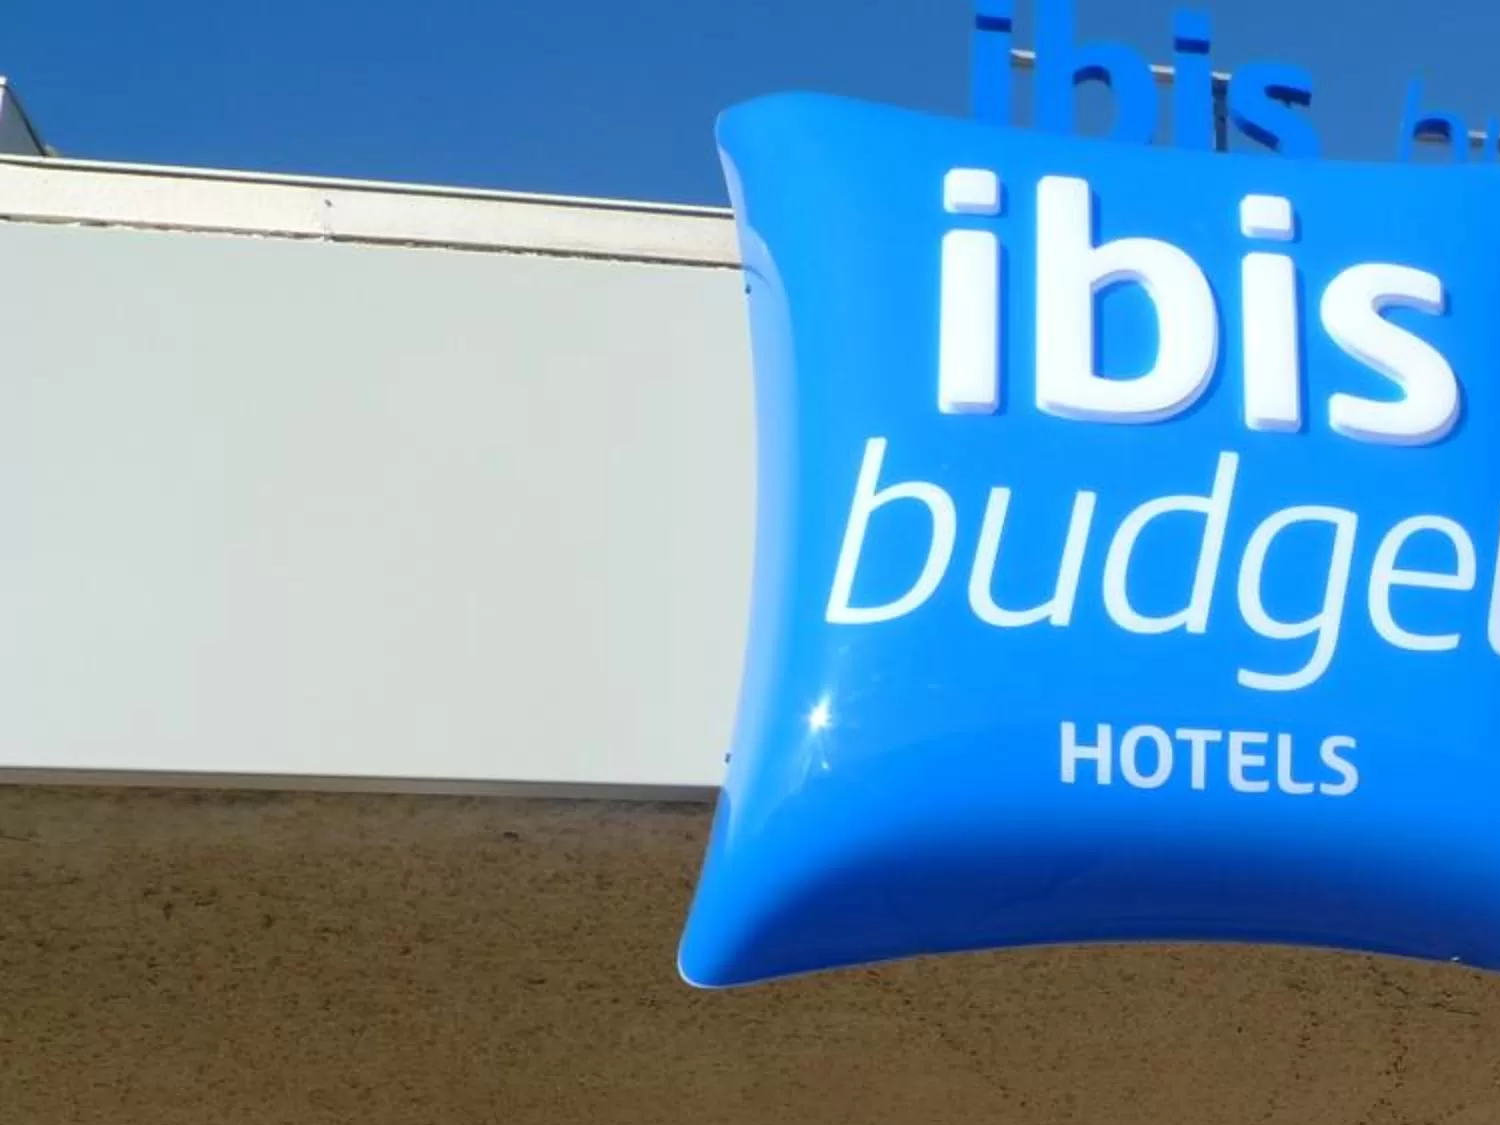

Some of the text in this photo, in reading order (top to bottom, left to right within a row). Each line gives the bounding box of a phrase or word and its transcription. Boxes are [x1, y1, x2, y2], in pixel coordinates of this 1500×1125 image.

[970, 0, 1320, 160] ibis
[937, 167, 1461, 448] ibis
[1059, 721, 1359, 797] HOTELS
